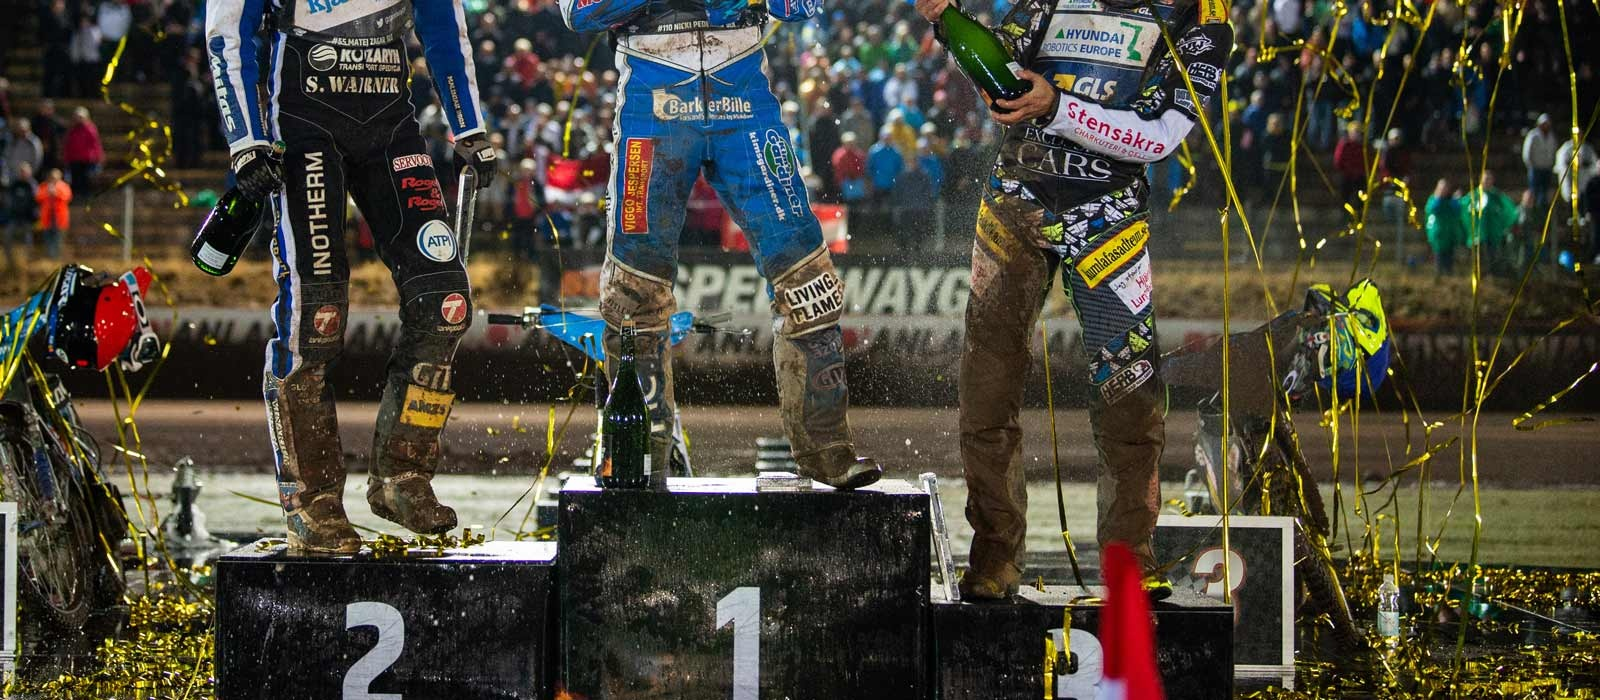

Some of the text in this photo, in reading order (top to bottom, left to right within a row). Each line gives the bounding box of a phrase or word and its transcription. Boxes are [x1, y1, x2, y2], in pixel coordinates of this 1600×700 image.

[674, 21, 692, 30] NICKI
[1066, 28, 1125, 45] HYUNDAI
[1079, 43, 1121, 58] EUROPE
[305, 76, 325, 93] S.
[1074, 77, 1118, 102] GLS
[1067, 102, 1166, 155] Stensåkra
[1074, 127, 1121, 151] CHARKUTERI
[1017, 143, 1113, 180] CARS
[623, 141, 643, 231] VIGGO JESPERSEN
[304, 151, 332, 276] INOTHERM
[342, 601, 405, 700] 2
[716, 586, 760, 700] 1
